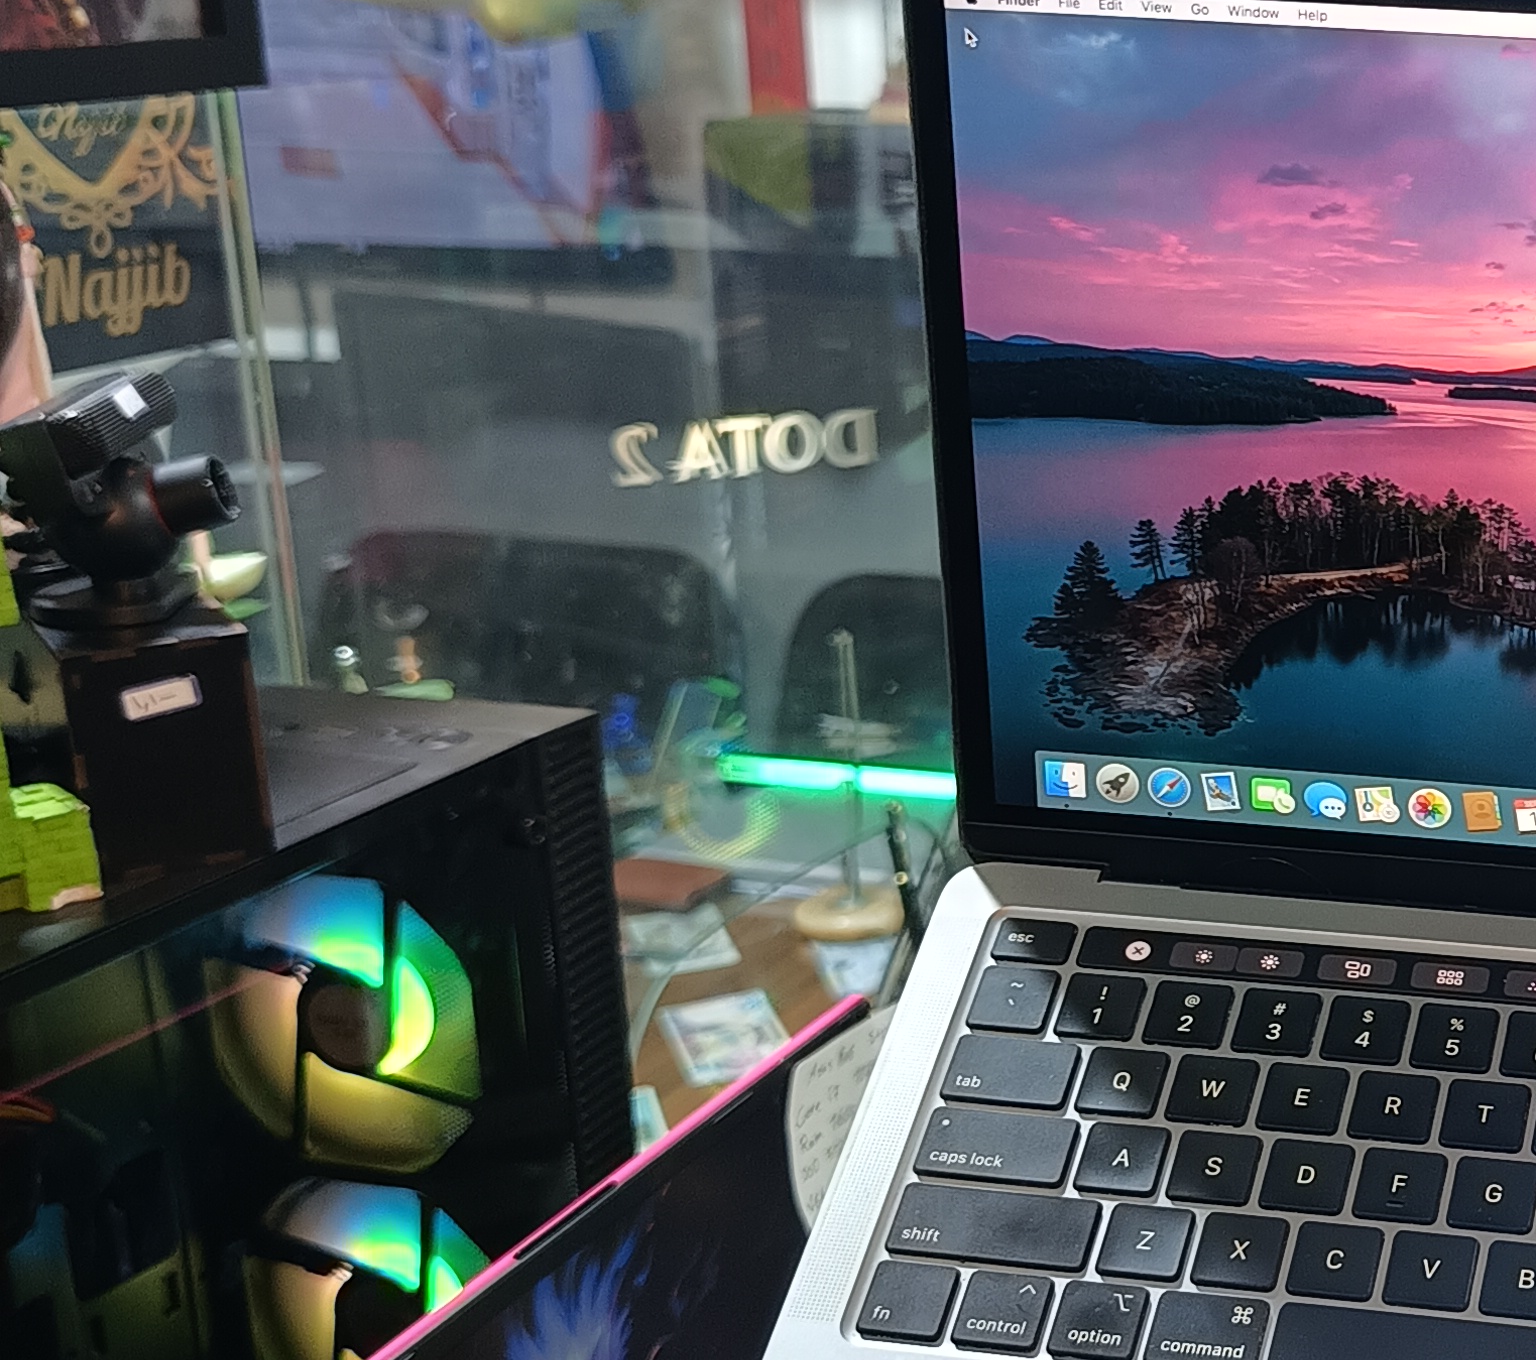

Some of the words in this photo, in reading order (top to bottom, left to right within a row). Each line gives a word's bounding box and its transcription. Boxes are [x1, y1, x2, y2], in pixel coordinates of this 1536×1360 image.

[1140, 0, 1172, 14] View
[1190, 3, 1210, 17] Go
[1227, 5, 1280, 20] Window
[1297, 9, 1328, 24] Help
[1006, 930, 1035, 945] esc
[1092, 1007, 1103, 1024] 1
[1176, 1015, 1194, 1032] 2
[1265, 1023, 1282, 1040] 3
[1354, 1031, 1370, 1048] 4
[1444, 1039, 1460, 1056] 5
[955, 1075, 981, 1088] tab
[1112, 1071, 1131, 1092] Q
[1201, 1079, 1226, 1098] W
[1294, 1087, 1311, 1106] E
[1384, 1096, 1402, 1115] R
[1478, 1104, 1495, 1123] T
[929, 1151, 968, 1165] caps
[969, 1152, 1004, 1168] lock
[1111, 1148, 1129, 1168] A
[1204, 1156, 1223, 1176] S
[1296, 1165, 1315, 1184] D
[1391, 1174, 1409, 1193] F
[1485, 1183, 1503, 1203] G
[901, 1226, 941, 1242] shift
[1135, 1230, 1156, 1250] Z
[1229, 1239, 1250, 1260] X
[1326, 1249, 1345, 1270] C
[1423, 1258, 1441, 1279] V
[1518, 1269, 1535, 1289] B
[872, 1305, 891, 1320] fn
[966, 1318, 1027, 1335] control
[1067, 1329, 1122, 1346] option
[1160, 1340, 1245, 1359] command
